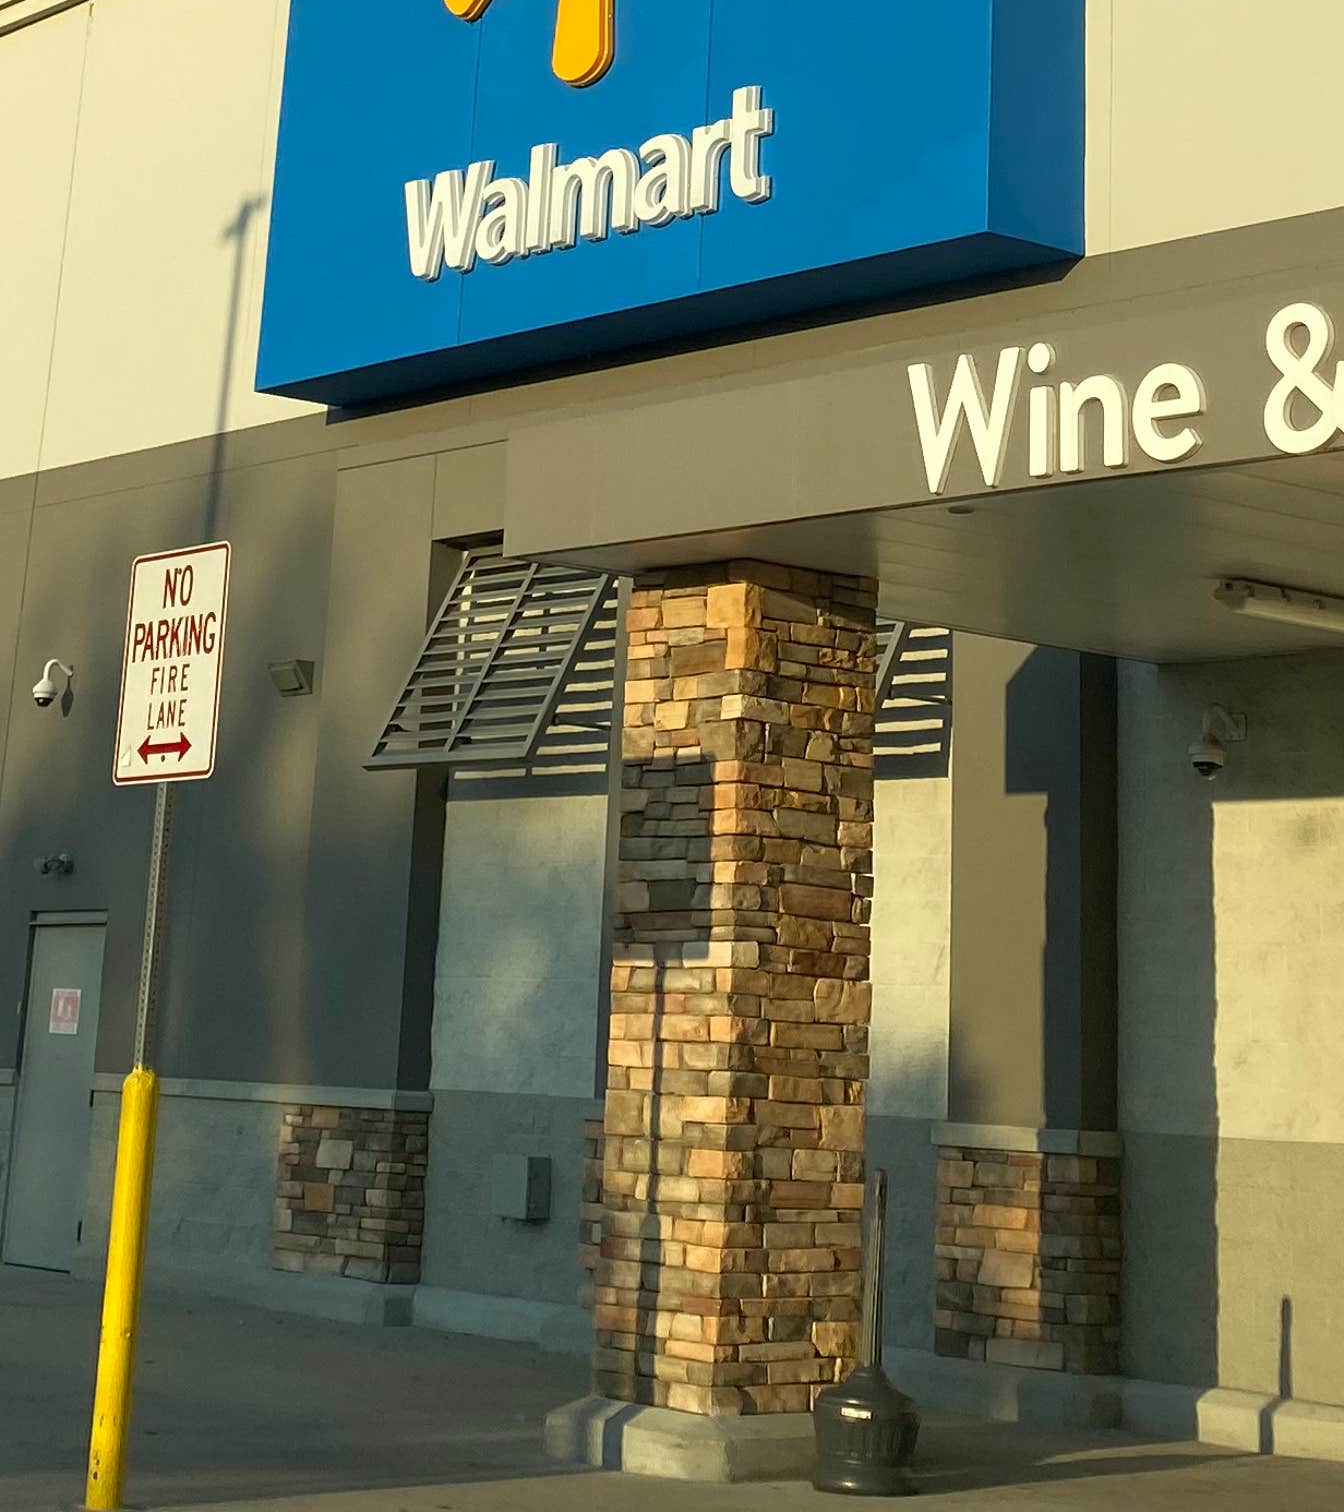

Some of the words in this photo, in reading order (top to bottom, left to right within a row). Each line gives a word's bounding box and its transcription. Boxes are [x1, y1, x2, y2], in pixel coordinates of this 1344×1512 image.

[404, 85, 775, 282] Walmart
[907, 341, 1206, 496] Wine
[162, 564, 194, 609] NO
[131, 611, 217, 664] PARKING
[150, 663, 191, 696] FIRE
[146, 698, 188, 731] LANE
